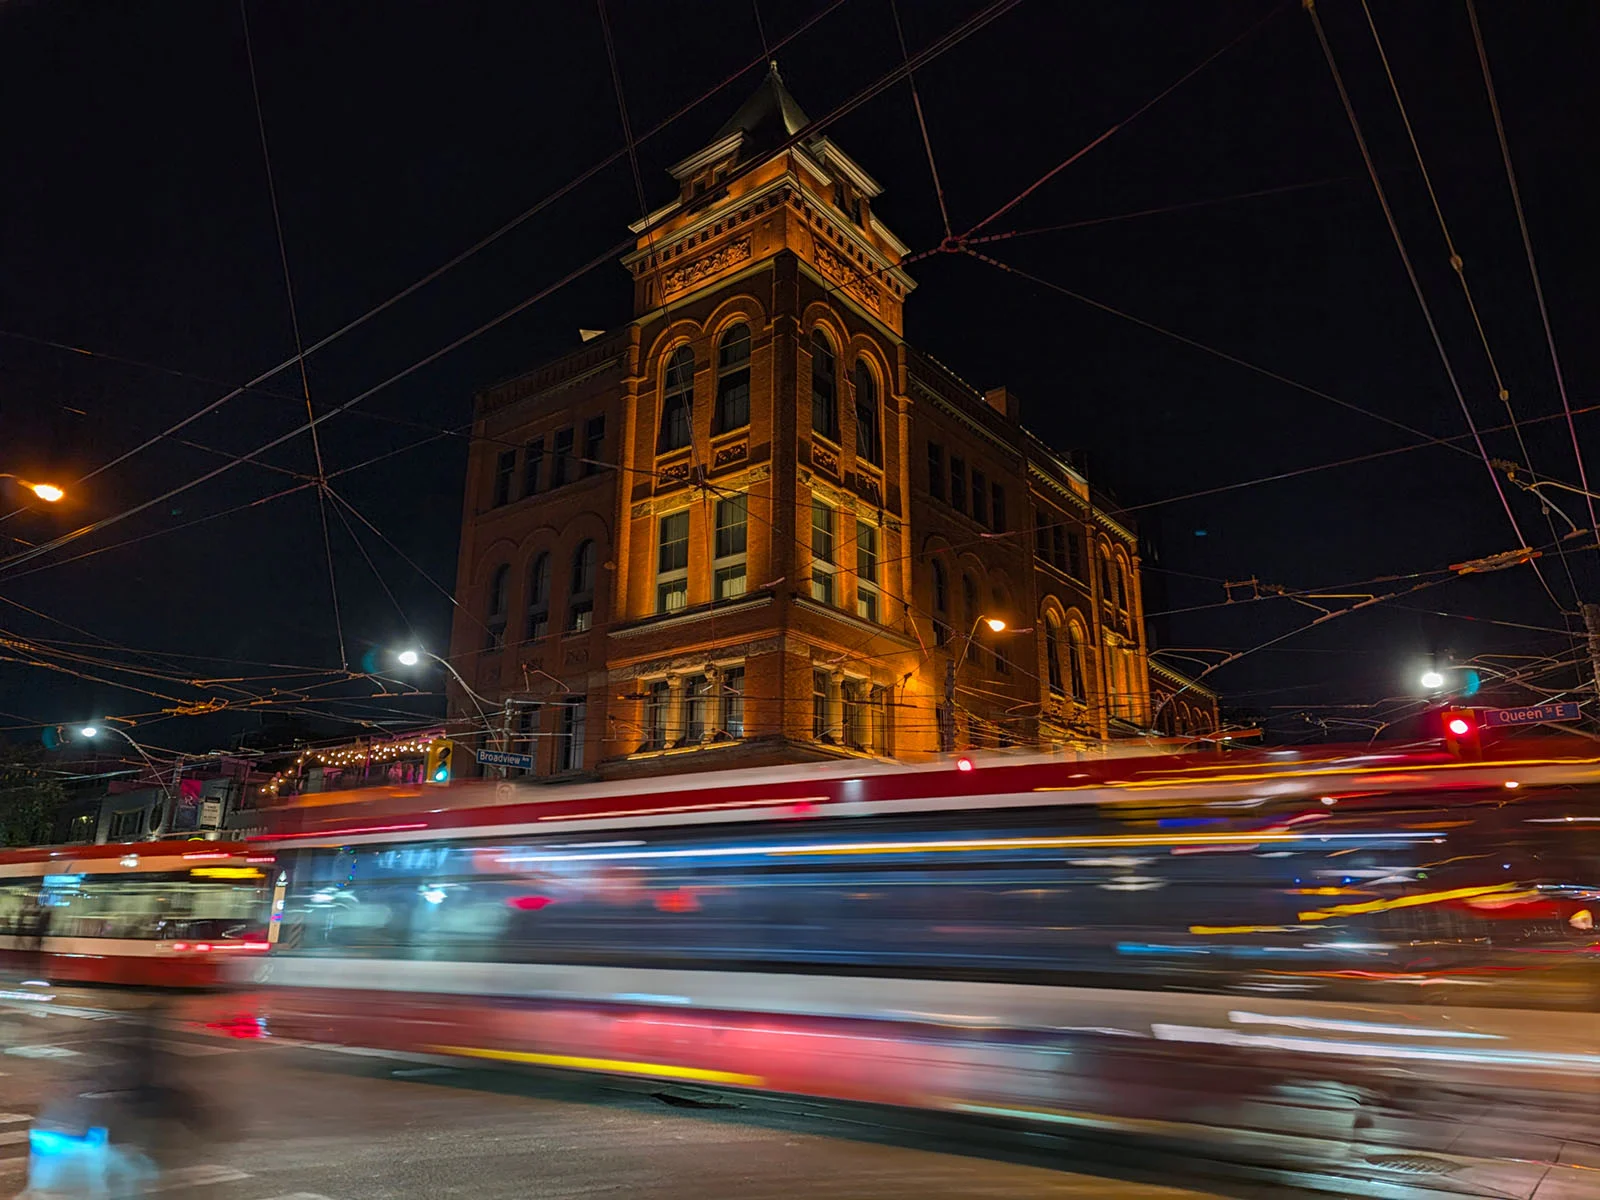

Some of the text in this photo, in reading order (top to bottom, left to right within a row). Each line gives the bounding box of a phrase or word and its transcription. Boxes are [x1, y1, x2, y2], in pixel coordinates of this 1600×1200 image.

[1499, 709, 1543, 724] Queen
[1556, 705, 1565, 717] E
[480, 751, 521, 765] Broadview
